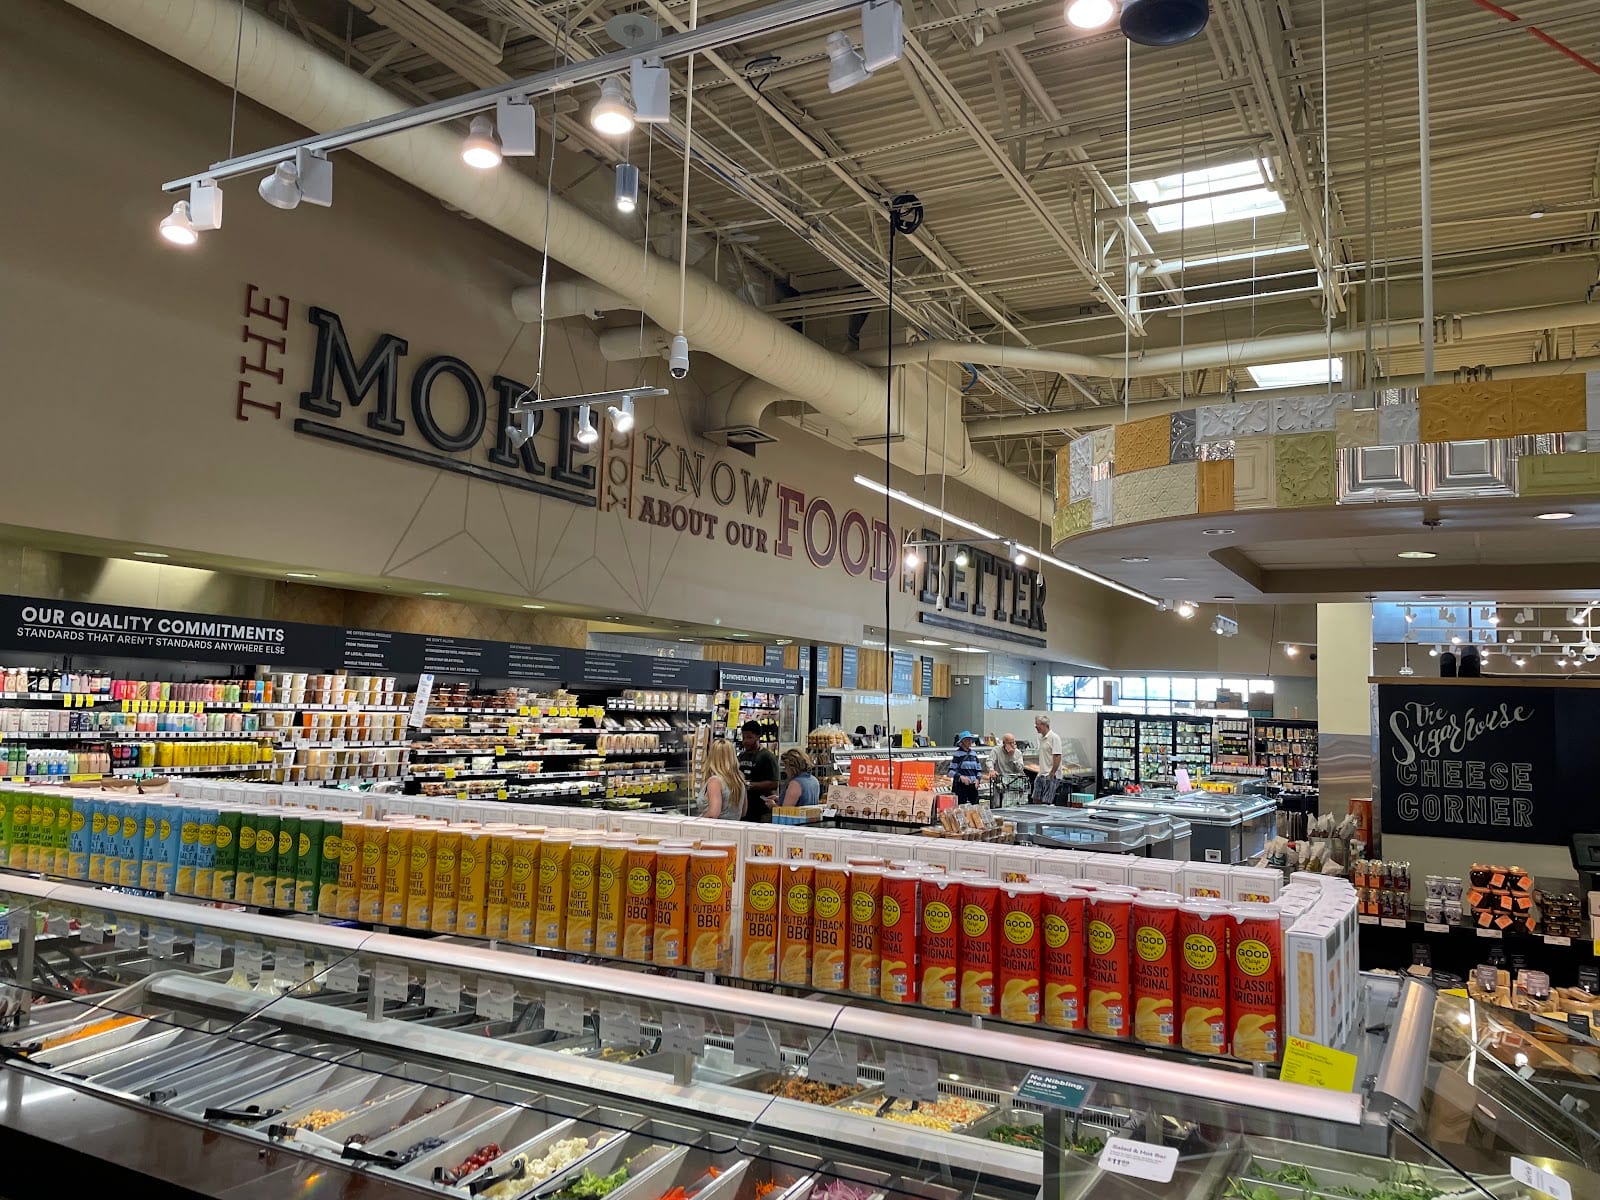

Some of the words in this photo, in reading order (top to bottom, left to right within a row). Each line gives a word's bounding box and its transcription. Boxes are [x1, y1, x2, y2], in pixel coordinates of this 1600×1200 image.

[236, 281, 290, 422] THE
[299, 306, 597, 489] MORE
[641, 433, 772, 518] KNOW
[639, 496, 718, 540] ABOUT
[726, 521, 768, 554] OUR
[774, 482, 898, 584] FOOD
[21, 606, 64, 624] OUR
[70, 611, 153, 631] QUALITY
[158, 619, 285, 642] COMMITMENTS
[17, 627, 84, 641] STANDARDS
[87, 632, 115, 643] THAT
[117, 635, 154, 645] AREN'T
[156, 638, 212, 649] STANDARDS
[214, 642, 263, 653] ANYWHERE
[265, 646, 285, 654] ELSE
[1405, 702, 1448, 727] The
[858, 764, 895, 776] DEALS
[1396, 759, 1533, 792] CHEESE
[1397, 792, 1534, 828] CORNER
[789, 891, 813, 900] GOOD
[627, 905, 648, 920] BBQ
[926, 909, 950, 918] GOOD
[697, 914, 720, 928] BBQ
[1005, 919, 1032, 929] GOOD
[749, 923, 773, 937] BBQ
[787, 926, 811, 940] BBQ
[815, 930, 838, 946] BBQ
[851, 933, 873, 952] BBQ
[1137, 934, 1164, 945] GOOD
[1185, 942, 1214, 953] GOOD
[1238, 948, 1269, 960] GOOD
[1233, 977, 1275, 994] CLASSIC
[1291, 1038, 1312, 1051] SALE
[1030, 1073, 1043, 1081] No
[1027, 1079, 1057, 1090] Please
[1112, 1143, 1132, 1153] Salad
